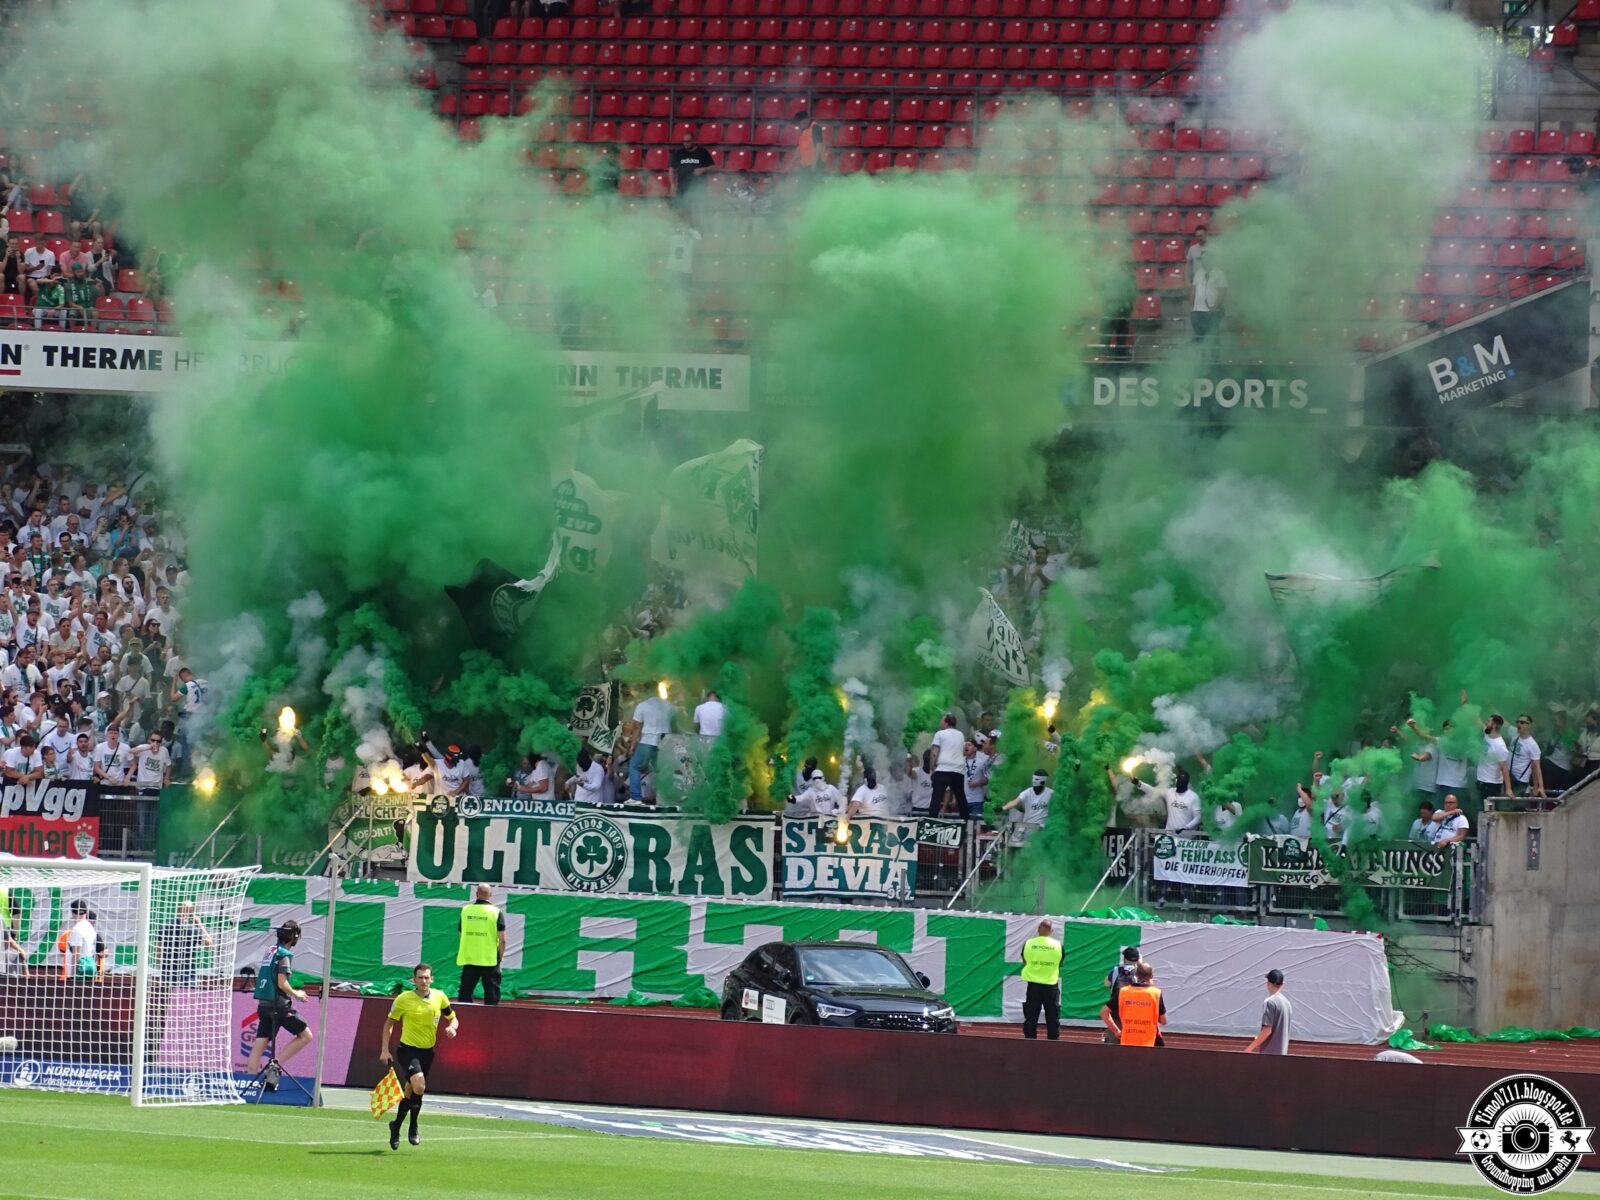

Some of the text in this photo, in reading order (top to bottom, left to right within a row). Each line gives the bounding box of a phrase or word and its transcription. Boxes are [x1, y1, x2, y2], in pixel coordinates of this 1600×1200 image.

[43, 345, 163, 371] THERME
[1427, 334, 1512, 394] B&M
[615, 366, 722, 390] THERME
[1093, 377, 1159, 406] DES
[0, 778, 87, 822] pVgg
[483, 801, 575, 816] ENTOURAGE
[562, 819, 623, 849] HORIDOS 1000
[785, 821, 891, 855] STRA
[1177, 839, 1209, 849] SEKTION
[1181, 849, 1236, 864] FEHLPASS
[566, 873, 615, 890] ULTRAS
[785, 857, 911, 893] DEVIA
[1164, 860, 1249, 879] DIE UNTERHOPFTEN
[45, 1065, 122, 1081] NÜRNBERGER
